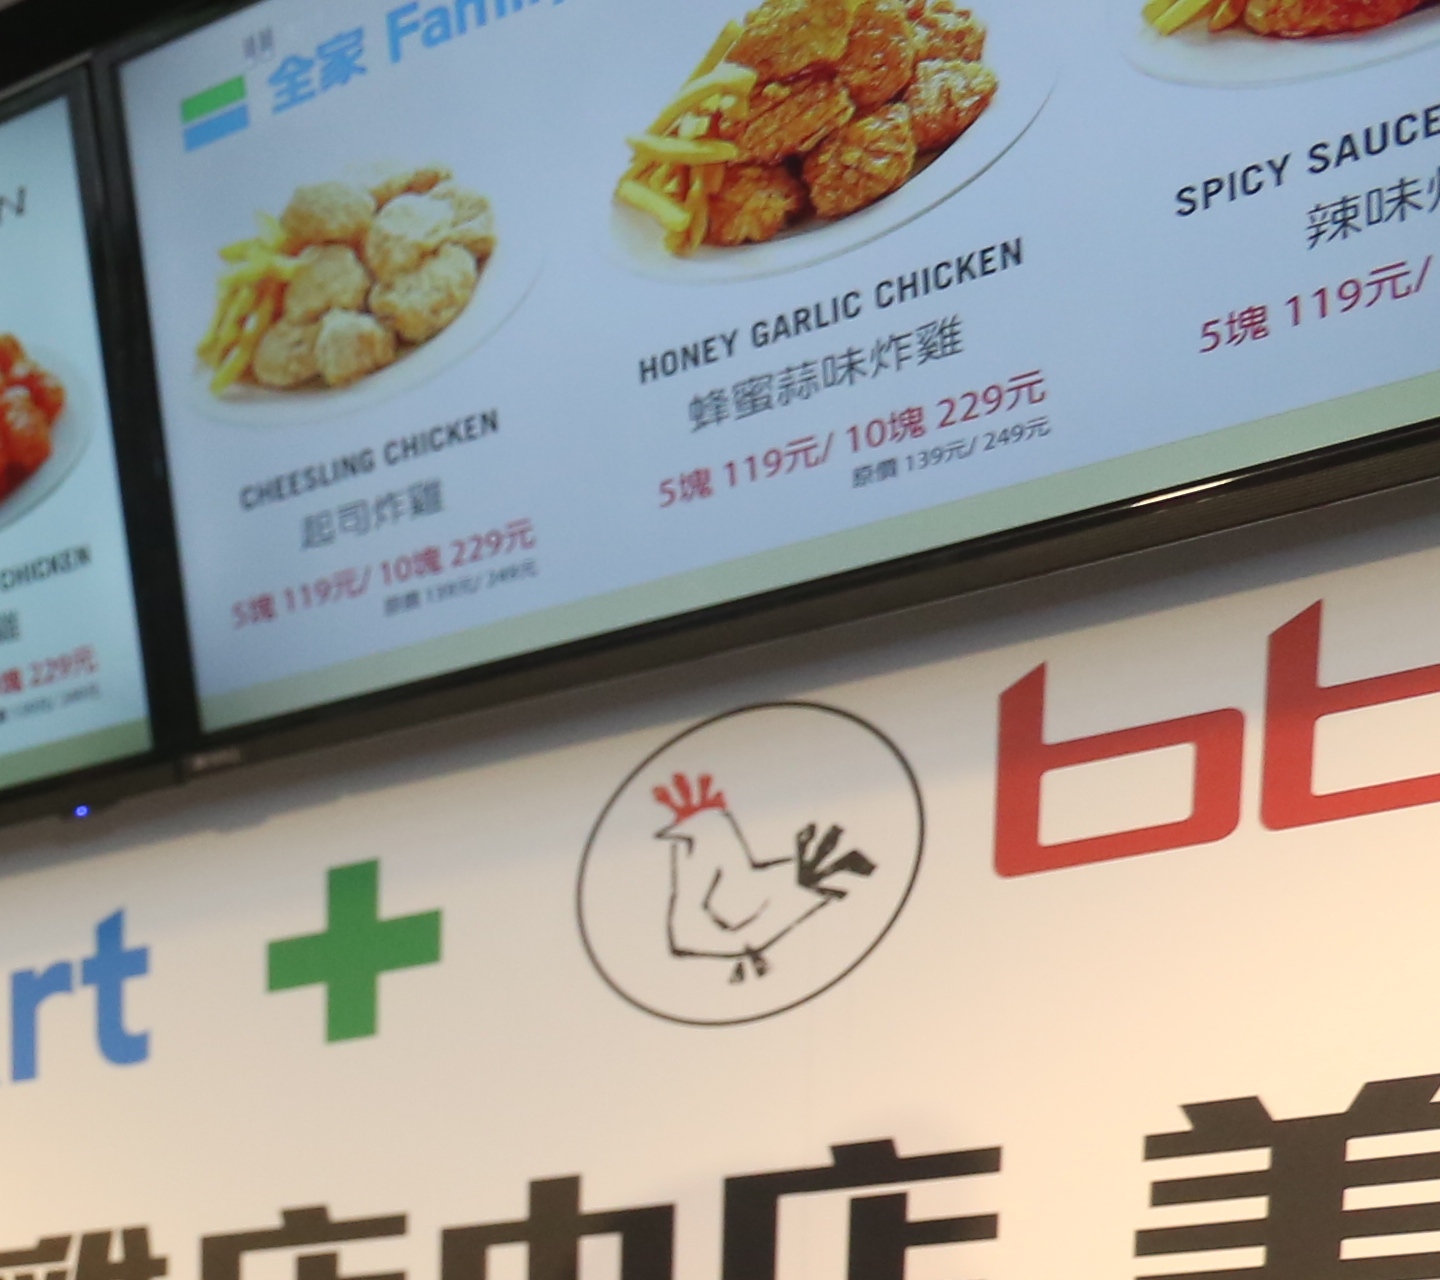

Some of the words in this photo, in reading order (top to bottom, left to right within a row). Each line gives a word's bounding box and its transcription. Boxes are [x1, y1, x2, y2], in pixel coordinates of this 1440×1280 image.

[268, 27, 368, 114] 全家
[1175, 152, 1292, 217] SPICY
[639, 329, 739, 384] HONEY
[750, 291, 862, 348] GARLIC
[874, 237, 1023, 309] CHICKEN
[1198, 303, 1270, 353] 5塊
[1284, 254, 1432, 327] 119元/
[687, 314, 967, 433] 蜂蜜蒜味炸雞
[238, 448, 375, 512] CHEESLING
[383, 408, 500, 467] CHICKEN
[659, 467, 715, 508] 5塊
[723, 432, 835, 489] 119元/
[846, 406, 927, 453] 10塊
[936, 370, 1048, 430] 229元
[982, 415, 1052, 452] 249元
[450, 517, 538, 568] 229元
